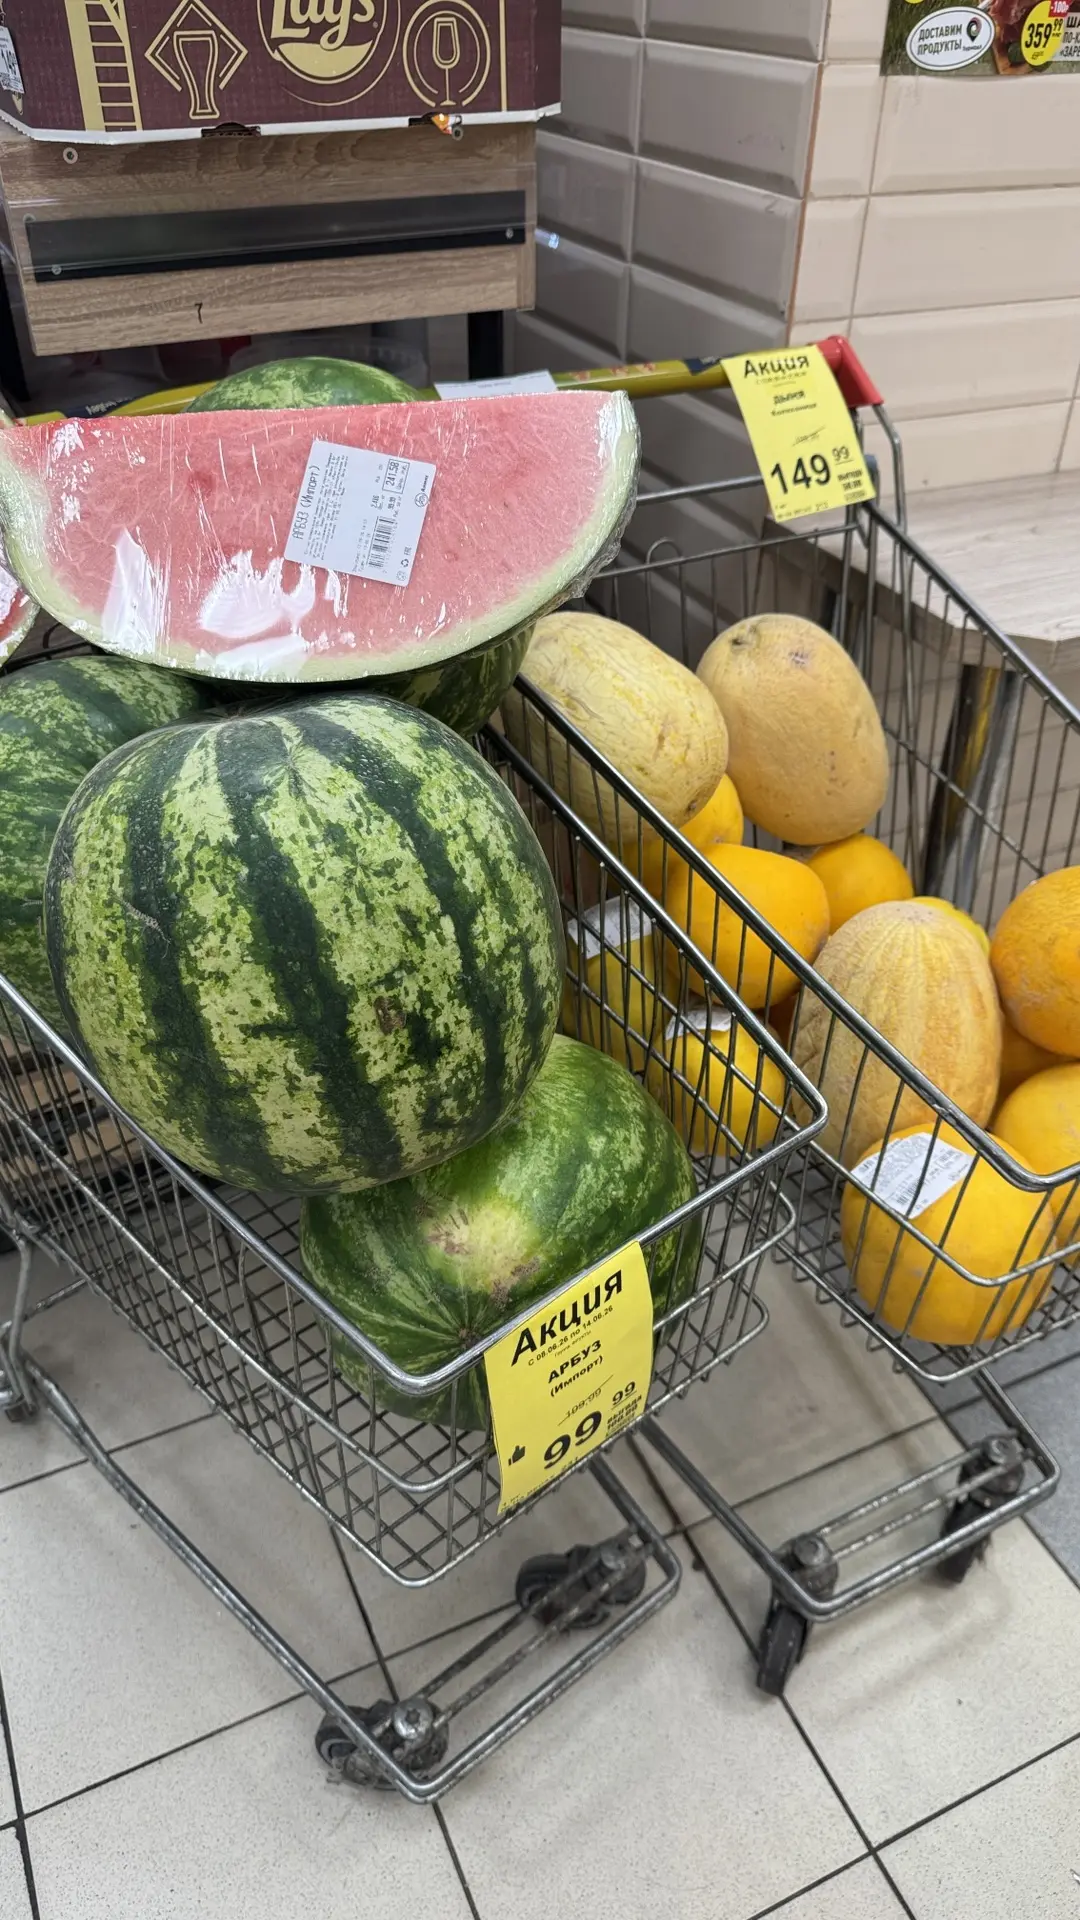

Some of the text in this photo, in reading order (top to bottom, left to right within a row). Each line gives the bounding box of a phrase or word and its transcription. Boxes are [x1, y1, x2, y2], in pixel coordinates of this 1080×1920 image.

[917, 39, 962, 56] ПРОДУКТЫ
[918, 24, 963, 42] ДОСТАВИМ
[1025, 18, 1064, 48] 359 99
[744, 355, 810, 378] Акция
[771, 445, 850, 494] 149 99
[292, 511, 309, 540] АРБУЗ
[511, 1269, 623, 1367] Акция
[536, 1336, 569, 1361] 08.06.26
[570, 1329, 580, 1338] по
[583, 1305, 613, 1329] 14.06.26
[548, 1340, 601, 1384] АРБУЗ
[550, 1355, 603, 1397] (Импорт)
[544, 1410, 602, 1470] 99
[612, 1381, 636, 1406] 99
